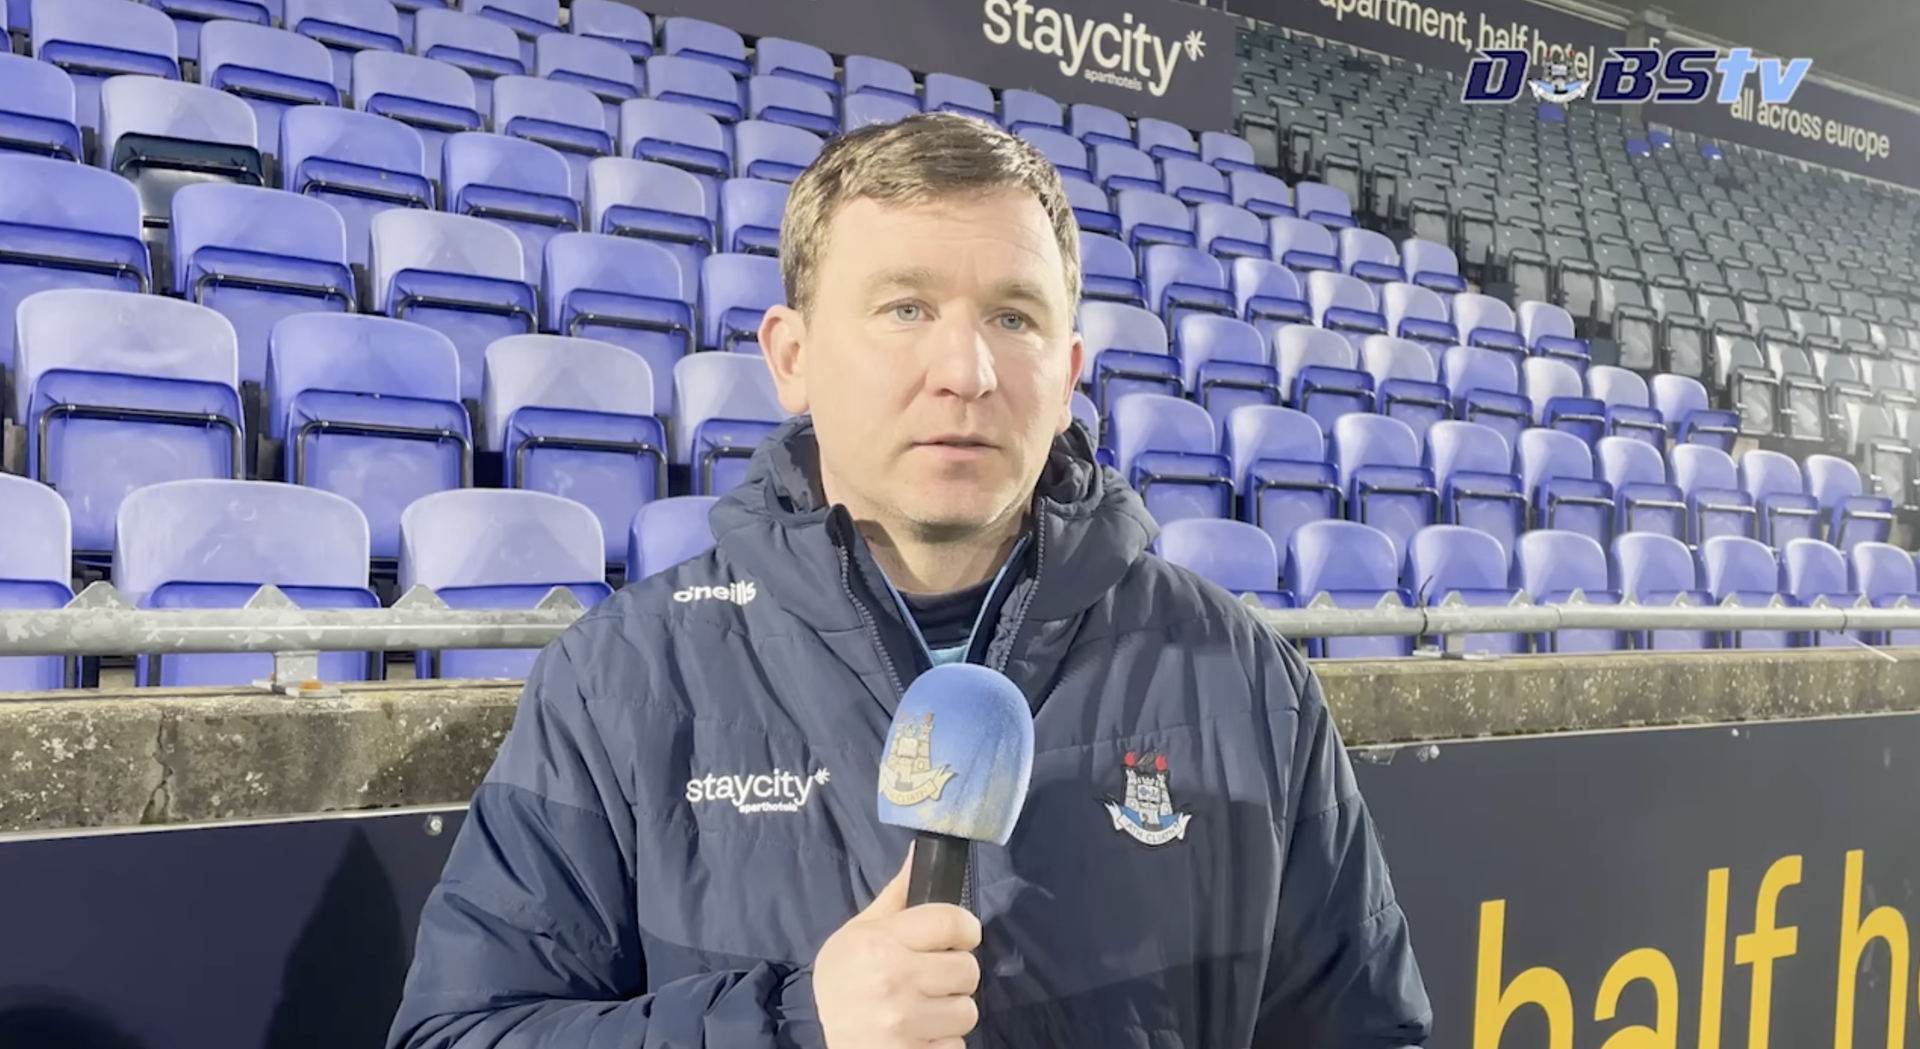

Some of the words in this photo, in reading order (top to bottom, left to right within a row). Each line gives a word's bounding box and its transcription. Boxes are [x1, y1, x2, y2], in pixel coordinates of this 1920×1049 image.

[983, 0, 1182, 97] staycity
[1083, 68, 1143, 91] aparthotels
[1730, 88, 1754, 121] all
[1757, 101, 1822, 140] across
[1825, 121, 1890, 162] europe
[685, 768, 814, 806] staycity
[738, 801, 799, 814] aparthotels
[1126, 823, 1144, 839] ATH
[1474, 855, 1802, 1049] half
